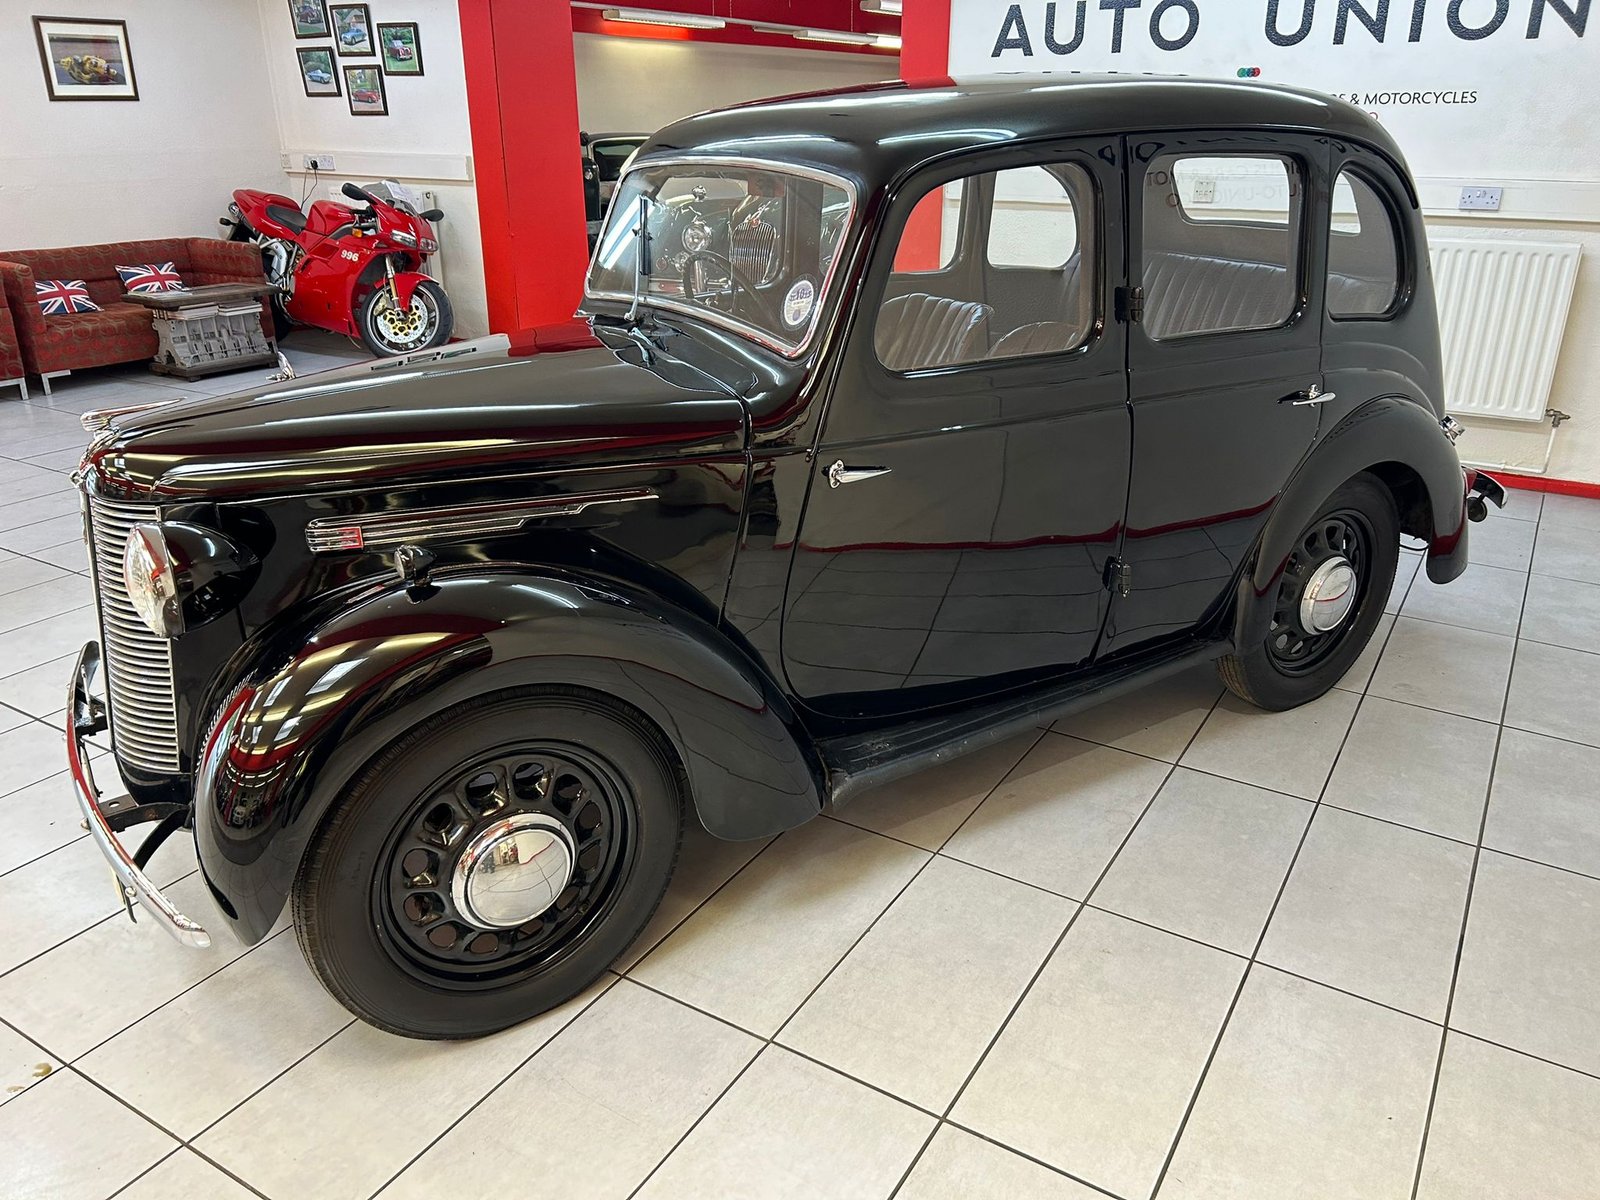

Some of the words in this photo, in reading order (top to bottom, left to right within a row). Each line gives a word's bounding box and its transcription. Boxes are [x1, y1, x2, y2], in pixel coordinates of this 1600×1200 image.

[991, 0, 1200, 58] AUTO
[1265, 0, 1593, 48] UNION
[1350, 93, 1359, 105] &
[1363, 91, 1477, 105] MOTORCYCLES
[341, 249, 358, 261] 996
